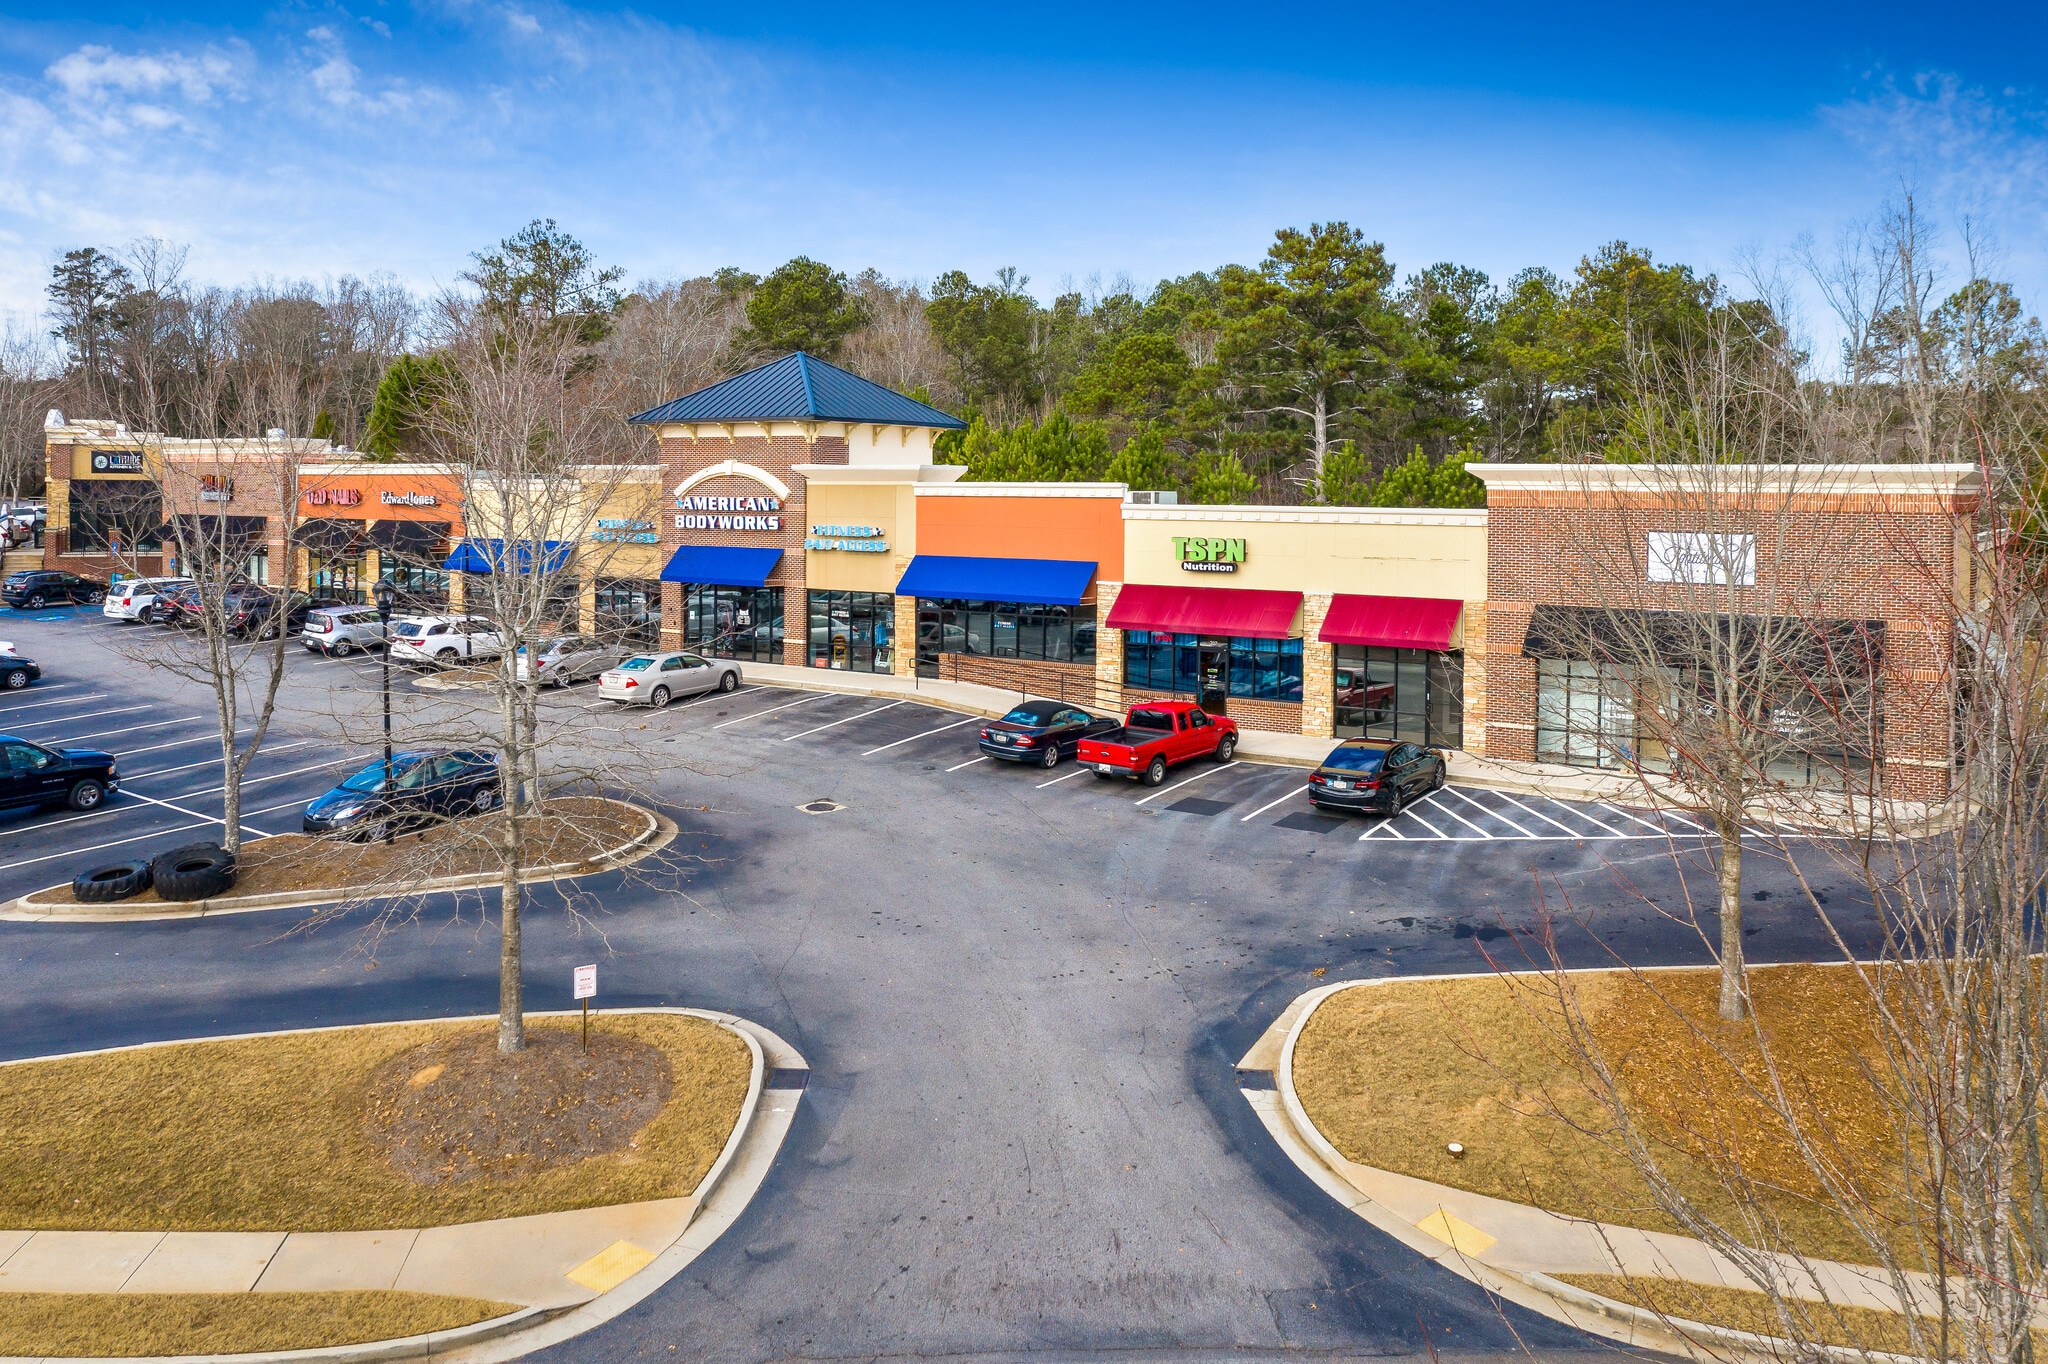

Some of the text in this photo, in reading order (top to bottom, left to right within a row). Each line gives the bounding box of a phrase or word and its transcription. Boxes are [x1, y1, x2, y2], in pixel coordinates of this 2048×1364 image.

[330, 489, 359, 505] NAILS
[381, 491, 435, 505] Edward Jones
[683, 497, 770, 511] AMERICAN
[675, 515, 779, 530] BODYWORKS
[817, 525, 873, 537] FITNESS
[804, 538, 886, 552] 24/7 ACCESS
[1172, 537, 1245, 562] TSPN
[1184, 562, 1233, 572] Nutrition
